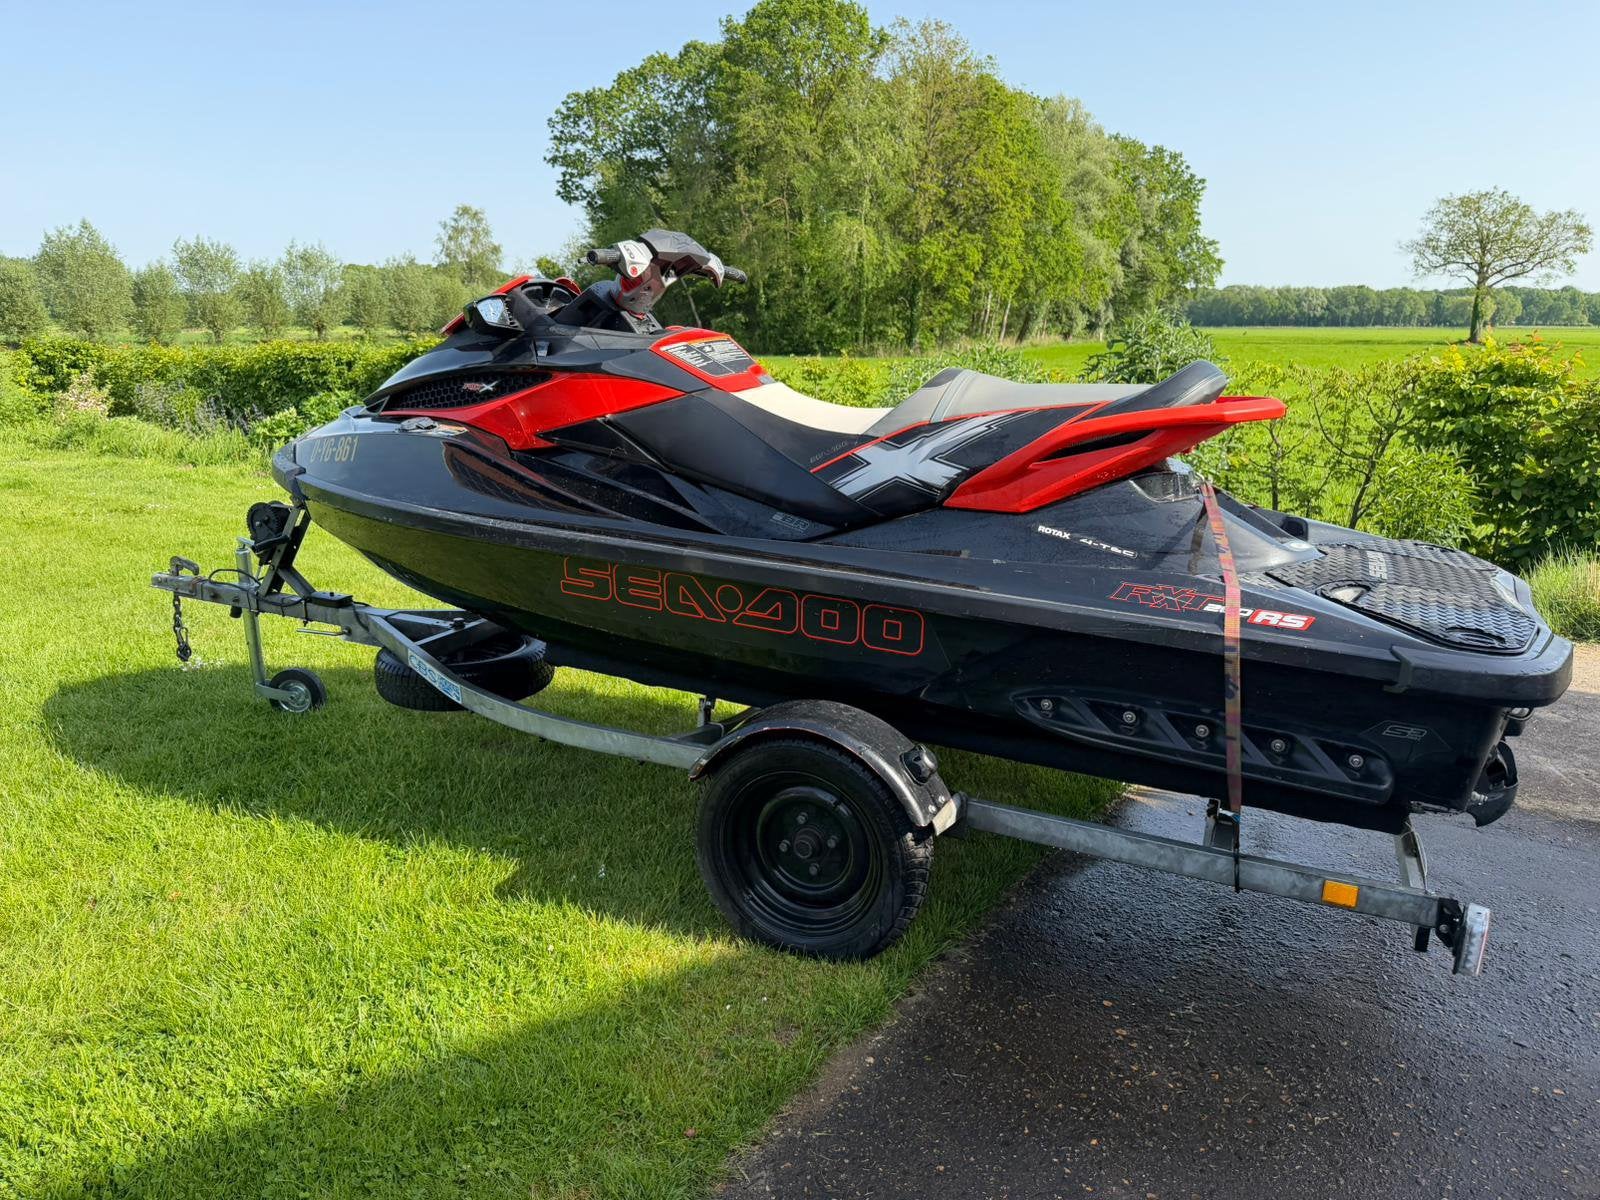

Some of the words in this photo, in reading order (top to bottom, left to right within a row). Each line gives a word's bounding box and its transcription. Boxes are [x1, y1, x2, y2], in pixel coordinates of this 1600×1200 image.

[1037, 525, 1070, 540] ROTAX
[1203, 603, 1254, 617] 20
[1253, 611, 1308, 628] RS
